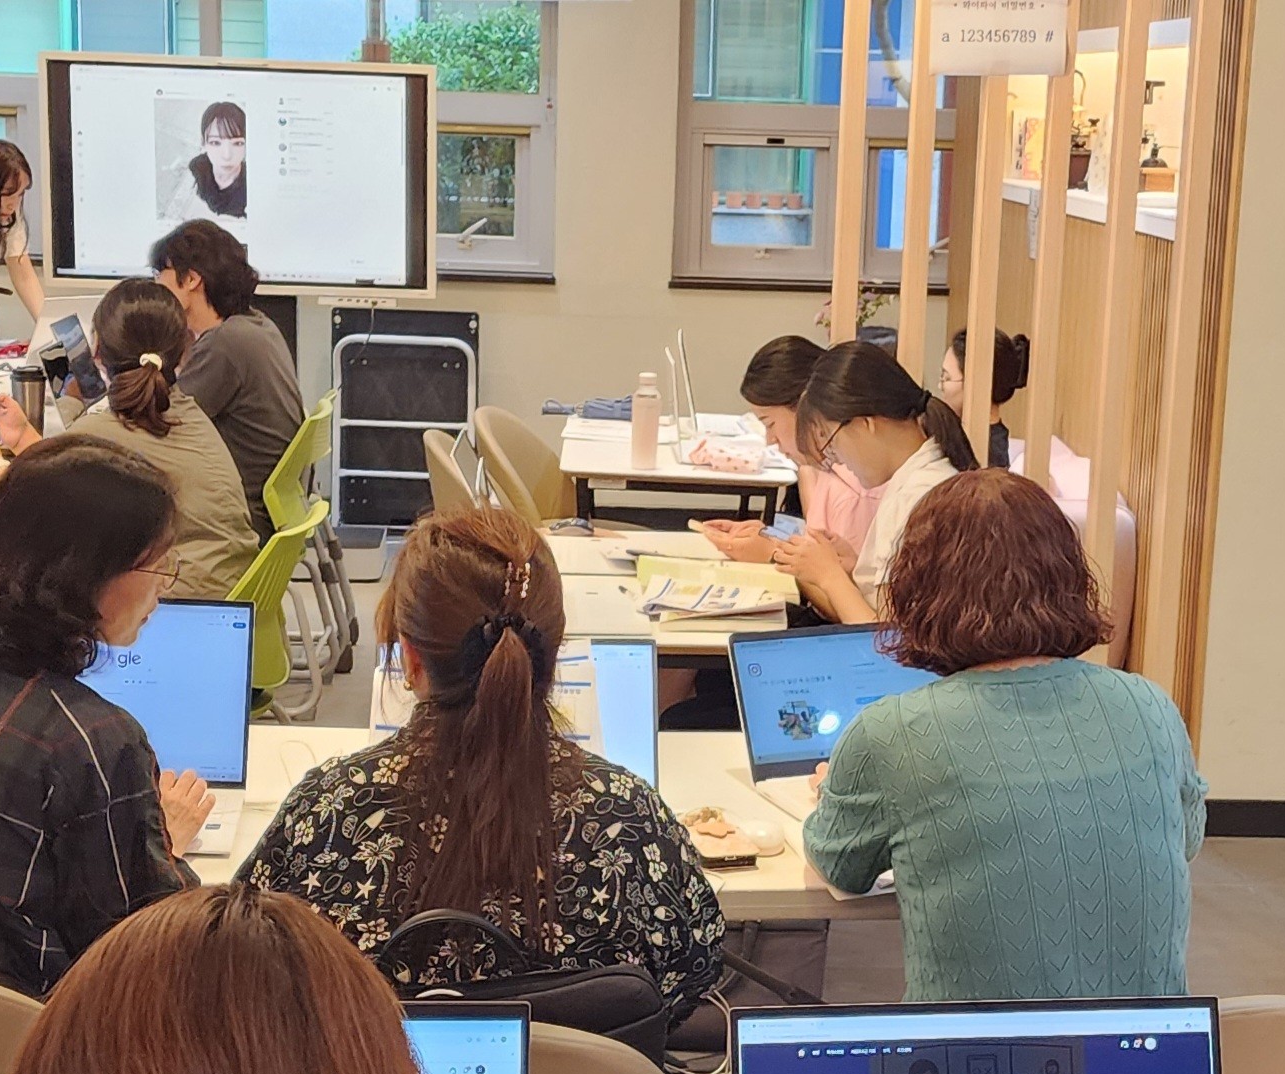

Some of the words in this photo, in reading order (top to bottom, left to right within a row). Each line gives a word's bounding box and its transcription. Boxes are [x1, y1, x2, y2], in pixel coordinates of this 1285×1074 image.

[1001, 1, 1035, 11] 비밀번호
[941, 33, 950, 43] a
[960, 29, 1037, 43] 123456789
[117, 650, 142, 668] gle
